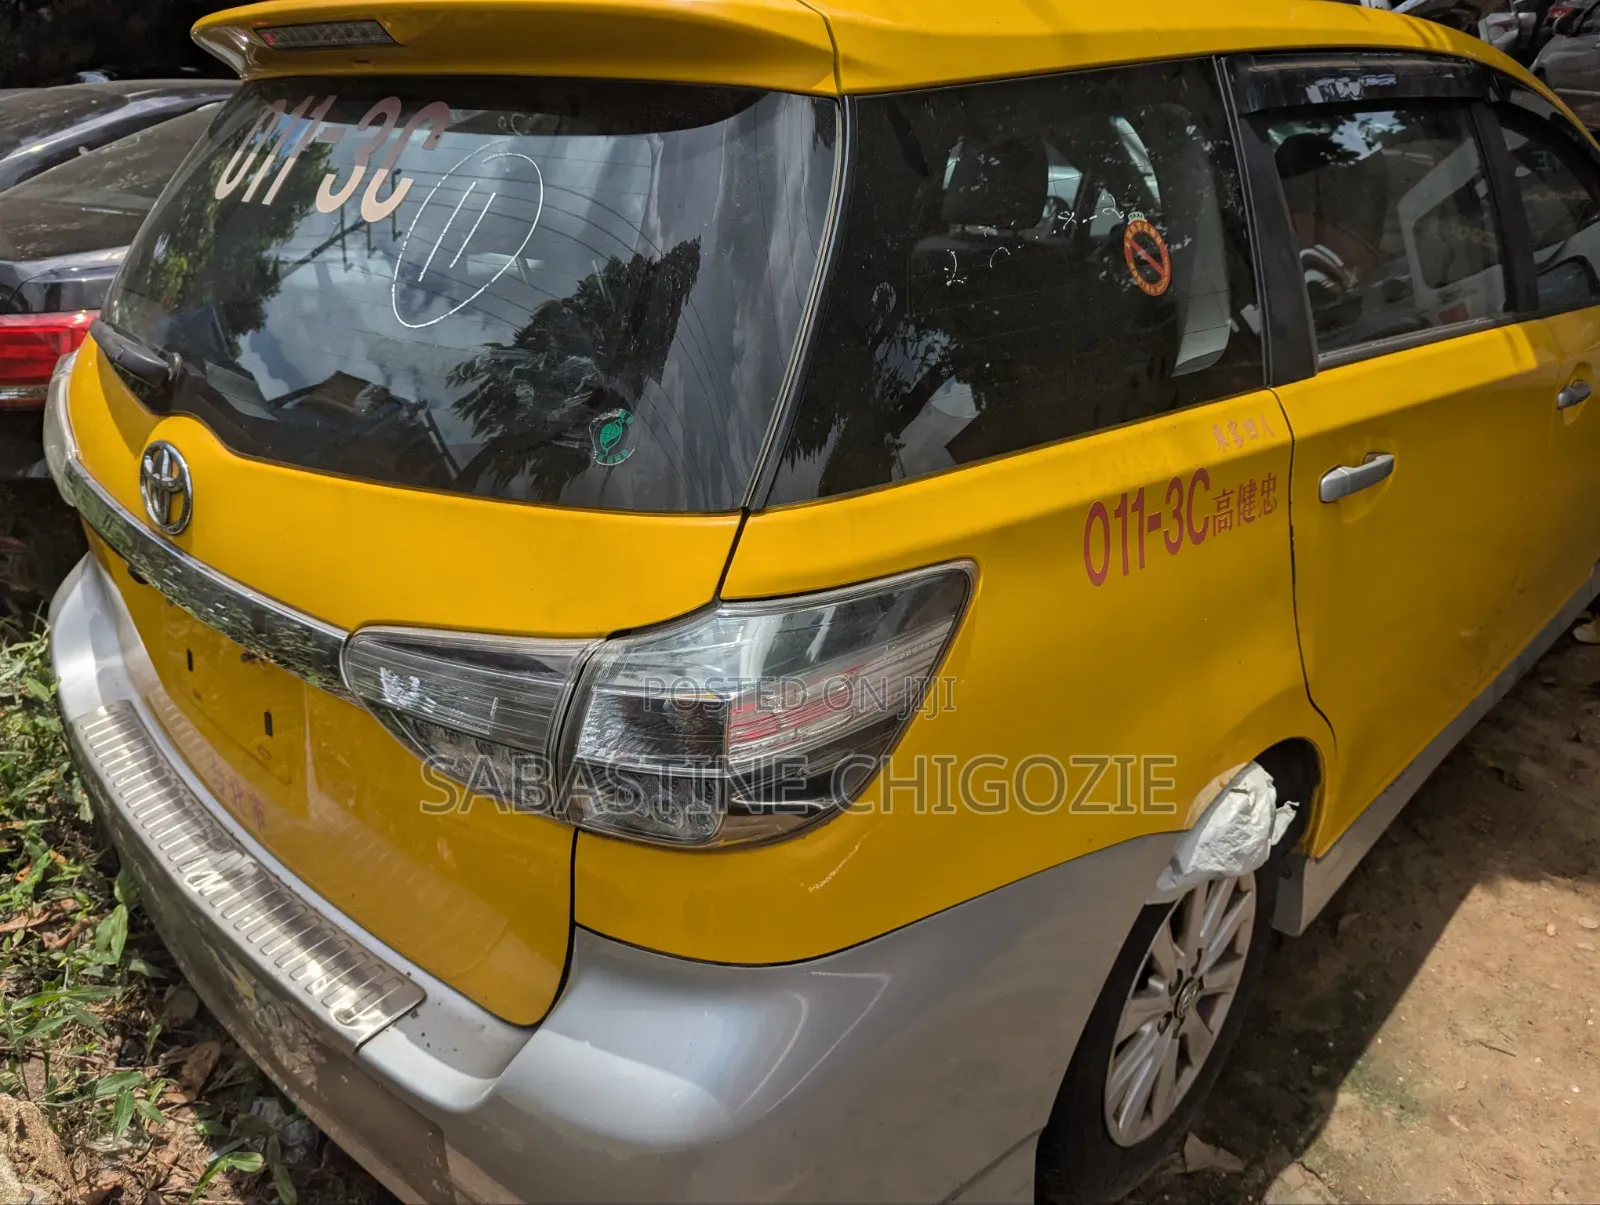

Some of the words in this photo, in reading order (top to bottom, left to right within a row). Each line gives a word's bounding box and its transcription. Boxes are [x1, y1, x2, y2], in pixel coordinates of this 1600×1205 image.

[215, 95, 451, 223] 011-3C
[1083, 467, 1211, 587] 011-3C
[1212, 472, 1278, 538] 高健忠
